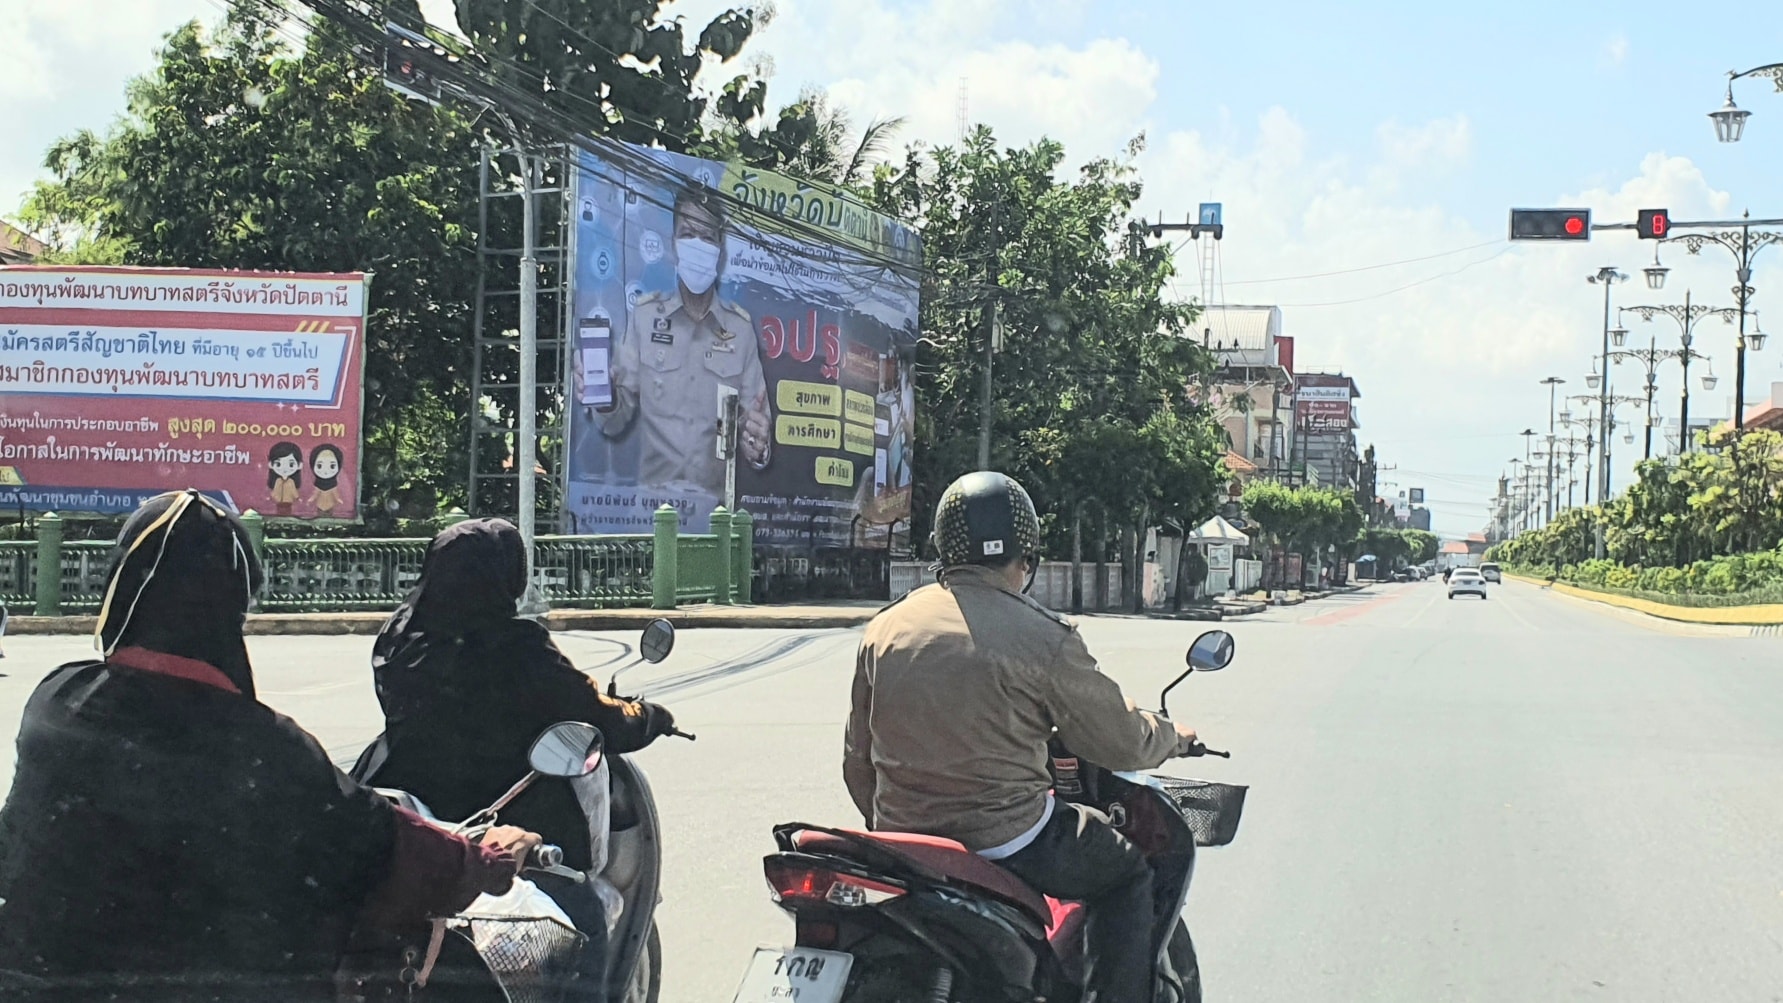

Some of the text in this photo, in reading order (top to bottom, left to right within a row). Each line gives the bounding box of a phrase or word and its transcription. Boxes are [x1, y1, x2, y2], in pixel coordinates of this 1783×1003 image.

[1652, 214, 1665, 235] 8
[192, 337, 239, 361] ที่มีอายุ
[272, 339, 319, 359] ปีขึ้นไป
[796, 391, 831, 407] สุขภาพ
[167, 416, 216, 439] สูงสุด
[222, 419, 303, 438] ๒๐๐,๐๐๐
[309, 422, 346, 438] บาท
[788, 423, 836, 439] การศึกษา
